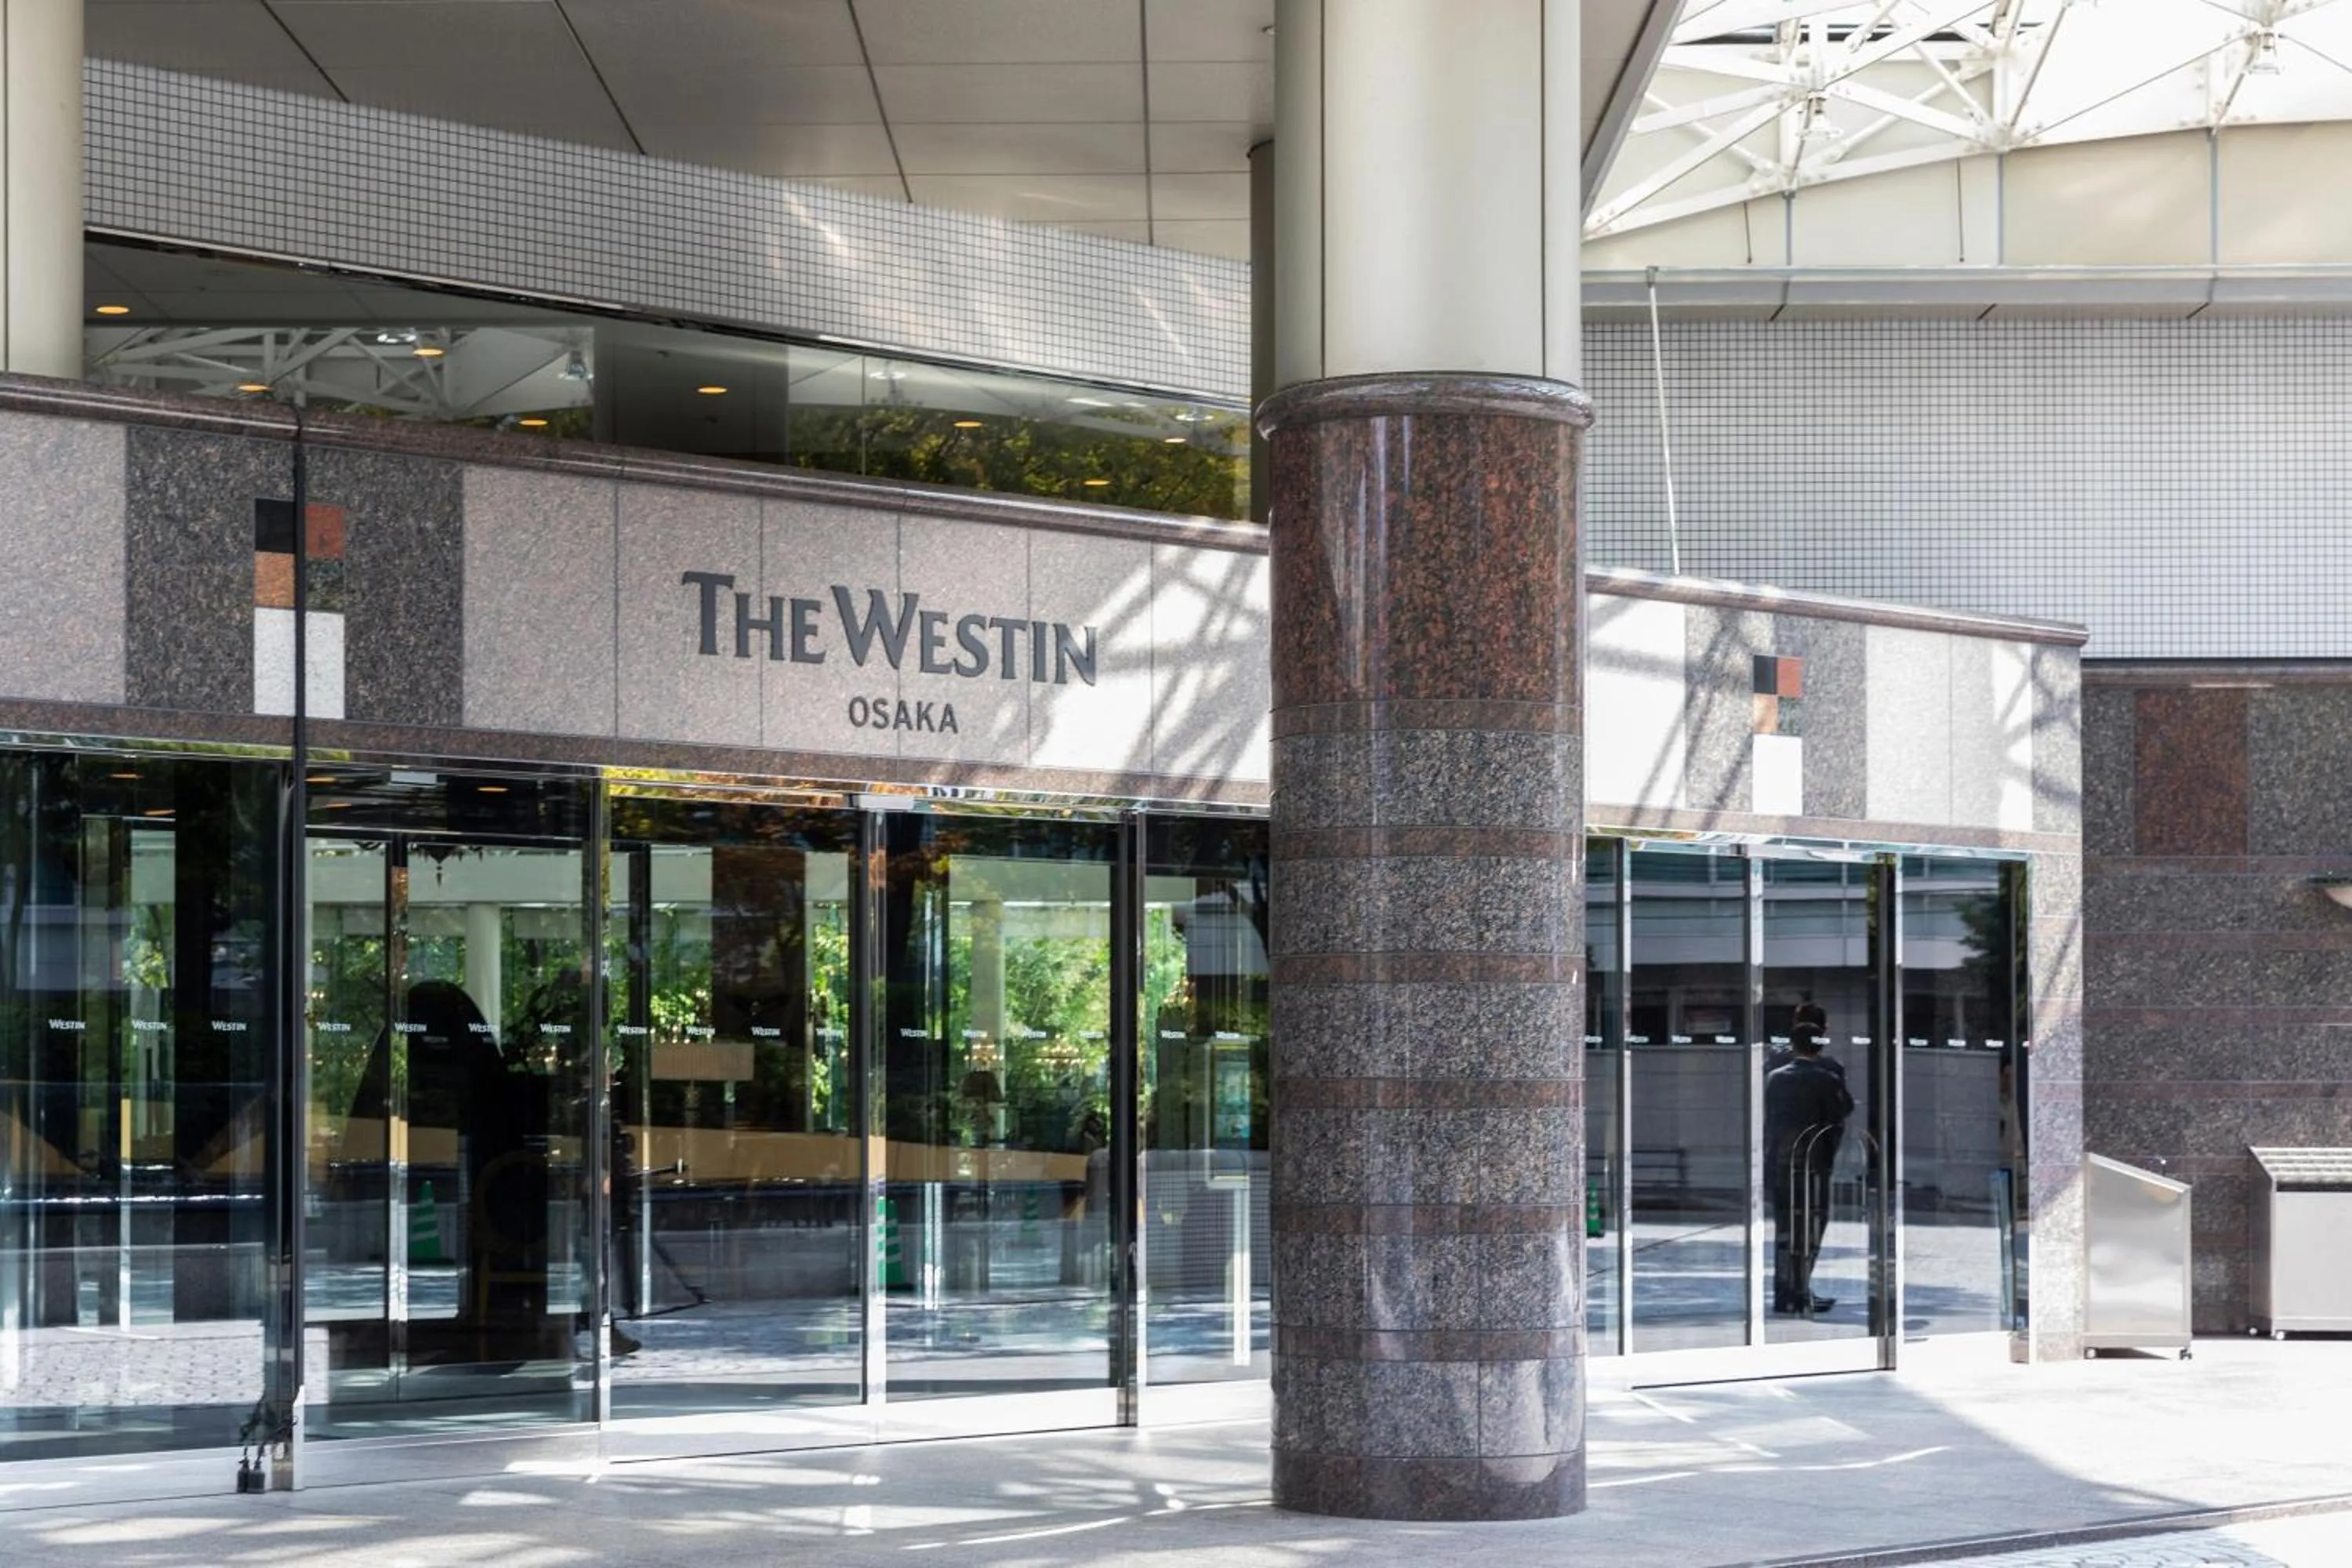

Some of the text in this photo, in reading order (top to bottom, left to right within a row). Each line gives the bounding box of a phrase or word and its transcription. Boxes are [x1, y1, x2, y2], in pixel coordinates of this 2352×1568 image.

[681, 571, 1098, 687] THE WESTIN
[848, 695, 960, 735] OSAKA
[49, 1019, 85, 1030] WESTIN
[132, 1019, 167, 1031] WESTIN
[211, 1020, 246, 1031] WESTIN
[317, 1022, 351, 1032] WESTIN
[394, 1022, 427, 1033] WESTIN
